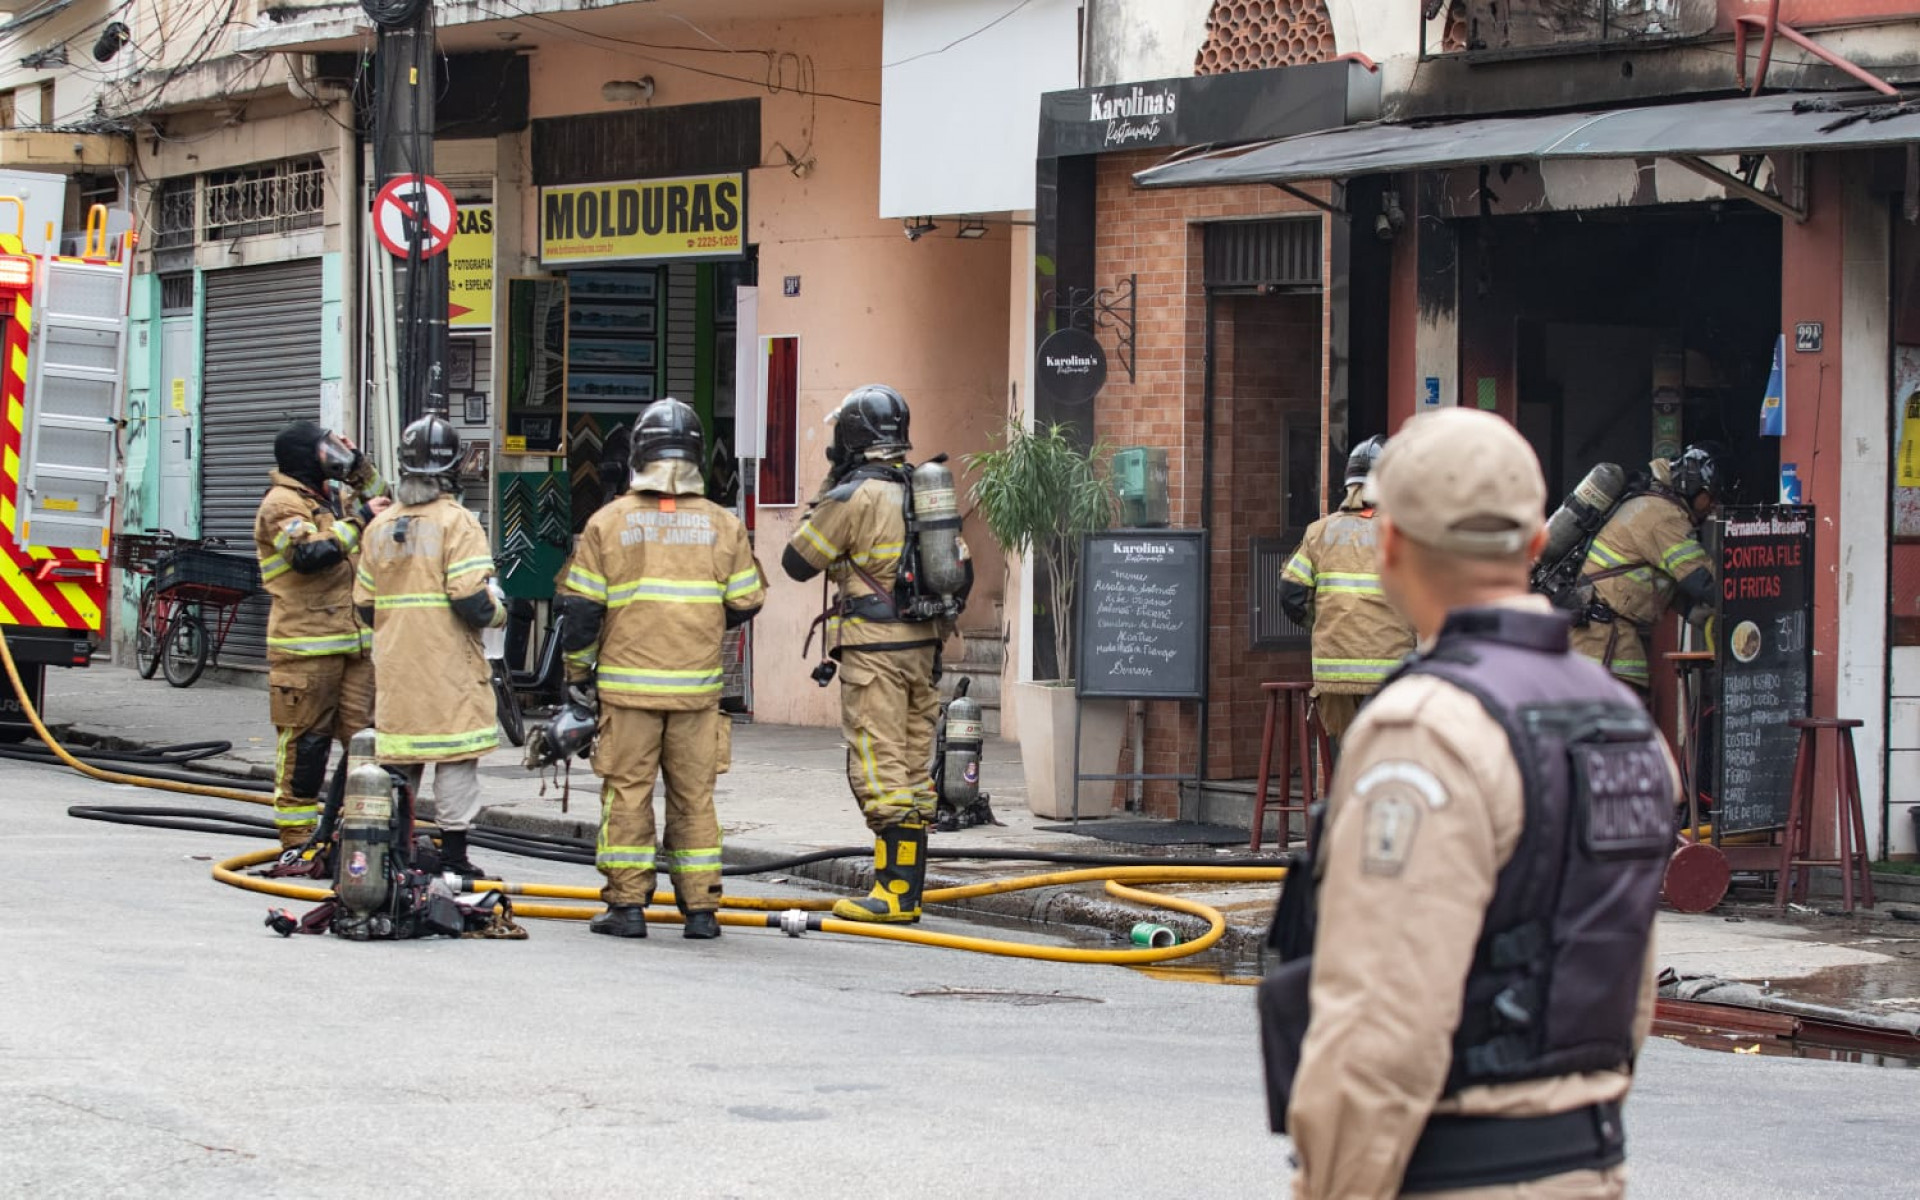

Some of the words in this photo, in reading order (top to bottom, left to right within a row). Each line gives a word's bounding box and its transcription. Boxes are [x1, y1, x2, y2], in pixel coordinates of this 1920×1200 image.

[1090, 86, 1176, 121] Karolina's
[546, 182, 738, 241] MOLDURAS
[453, 258, 493, 270] FOTOGRAFIA
[1046, 354, 1098, 367] Karolina's
[626, 511, 710, 530] BOMBEIROS
[1724, 519, 1770, 536] Fernandes
[1771, 517, 1807, 535] Braseiro
[620, 529, 643, 547] RIO
[1113, 542, 1175, 554] Karolina's
[1724, 545, 1775, 569] CONTRA
[1740, 575, 1781, 599] FRITAS
